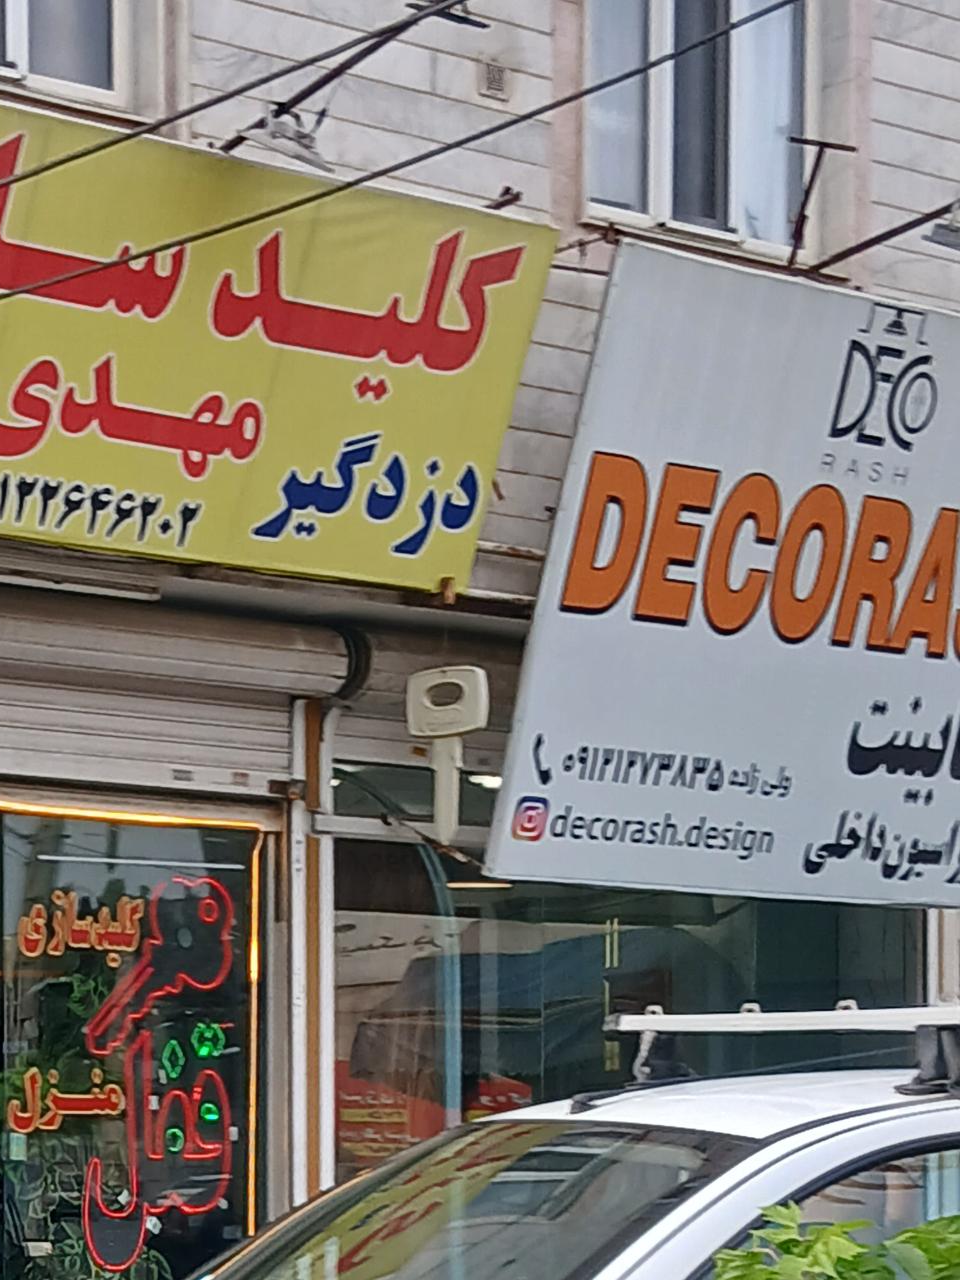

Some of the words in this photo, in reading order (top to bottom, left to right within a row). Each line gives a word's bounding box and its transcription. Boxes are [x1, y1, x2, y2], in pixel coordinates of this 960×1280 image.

[828, 339, 938, 452] DECO
[250, 433, 479, 556] دزدگیر
[820, 452, 909, 486] RASH
[559, 450, 960, 660] DECORA
[549, 805, 775, 861] decorash.design
[7, 1065, 126, 1134] منزل
